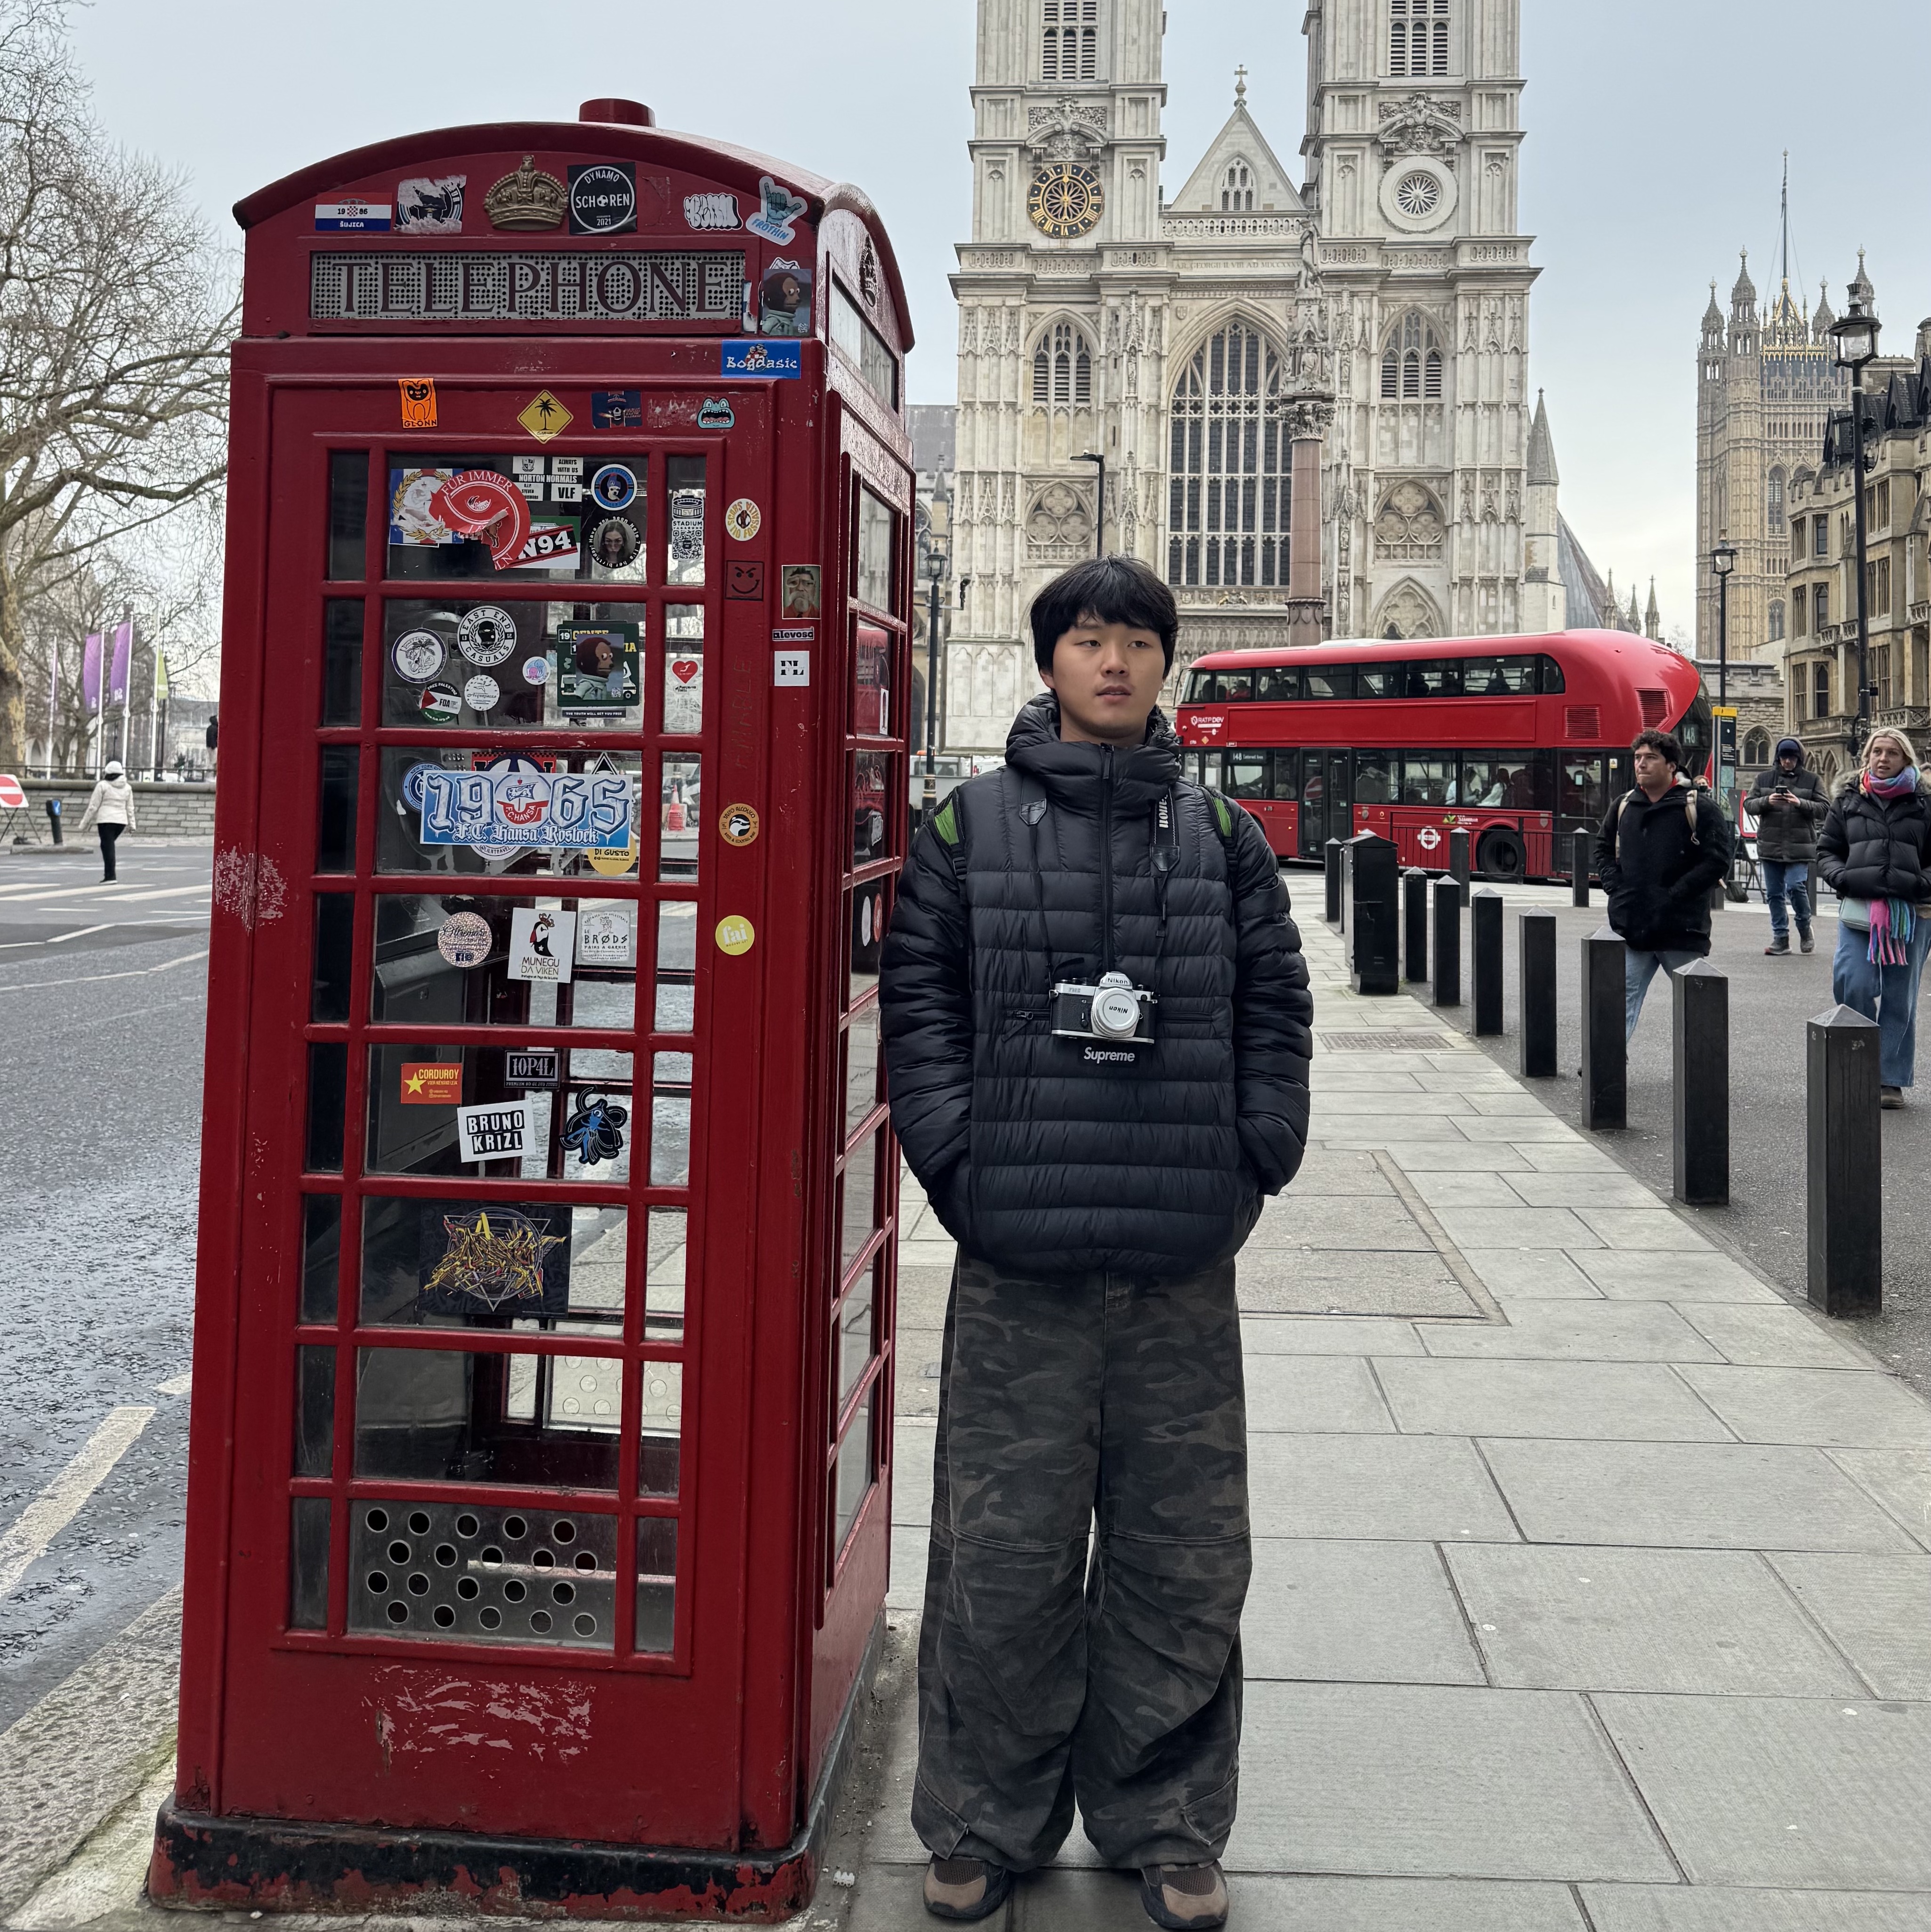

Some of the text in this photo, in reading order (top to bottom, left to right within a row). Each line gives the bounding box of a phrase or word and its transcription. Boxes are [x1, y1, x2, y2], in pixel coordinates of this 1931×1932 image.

[584, 170, 620, 184] DYNAMO
[597, 218, 611, 226] 2021
[751, 218, 789, 240] FROTHIN
[332, 261, 728, 313] TELEPHONE
[726, 356, 798, 371] Bogdasic
[404, 419, 437, 427] GLÖNN
[469, 471, 513, 492] IMMER
[519, 474, 577, 483] NORTON NORMALS
[557, 487, 575, 499] VLF
[589, 527, 597, 543] Have
[462, 609, 511, 631] EAST END
[465, 645, 509, 663] CASUALS
[1684, 727, 1696, 744] 148
[1233, 752, 1242, 760] 148
[453, 823, 599, 846] F.C. Hansa Rostock
[723, 923, 748, 945] fai
[522, 956, 560, 967] MUNEGU
[535, 966, 559, 976] VIKEN
[1109, 1005, 1128, 1014] Nikon
[1083, 1046, 1135, 1064] Supreme
[419, 1069, 459, 1079] CORDUROY
[512, 1058, 554, 1076] 10P4L
[468, 1112, 523, 1133] BRUNO
[473, 1132, 522, 1152] KRIZL
